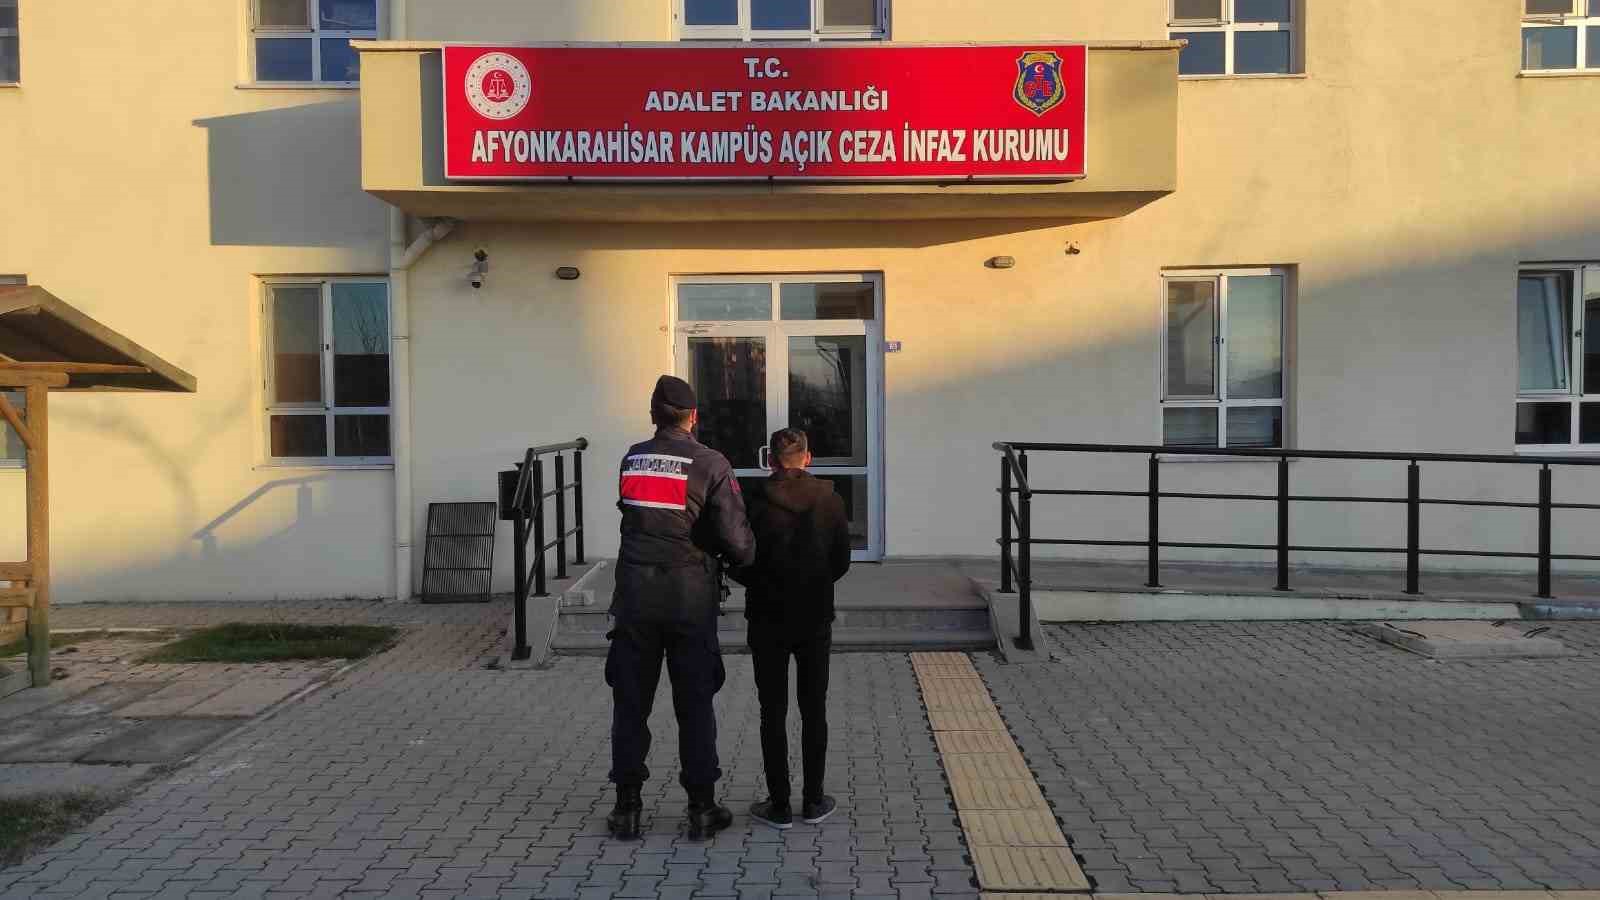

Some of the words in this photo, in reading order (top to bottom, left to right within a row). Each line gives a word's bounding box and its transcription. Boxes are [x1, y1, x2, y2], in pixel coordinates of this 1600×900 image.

[743, 57, 789, 78] T.C.
[645, 91, 742, 112] ADALET
[751, 85, 888, 112] BAKANLIĞI
[471, 123, 674, 164] AFYONKARAHİSAR
[680, 123, 773, 164] KAMPÜS
[779, 130, 833, 171] AÇIK
[839, 130, 897, 162] CEZA
[904, 121, 967, 162] İNFAZ
[973, 128, 1070, 162] KURUMU
[629, 459, 682, 473] JANDARMA
